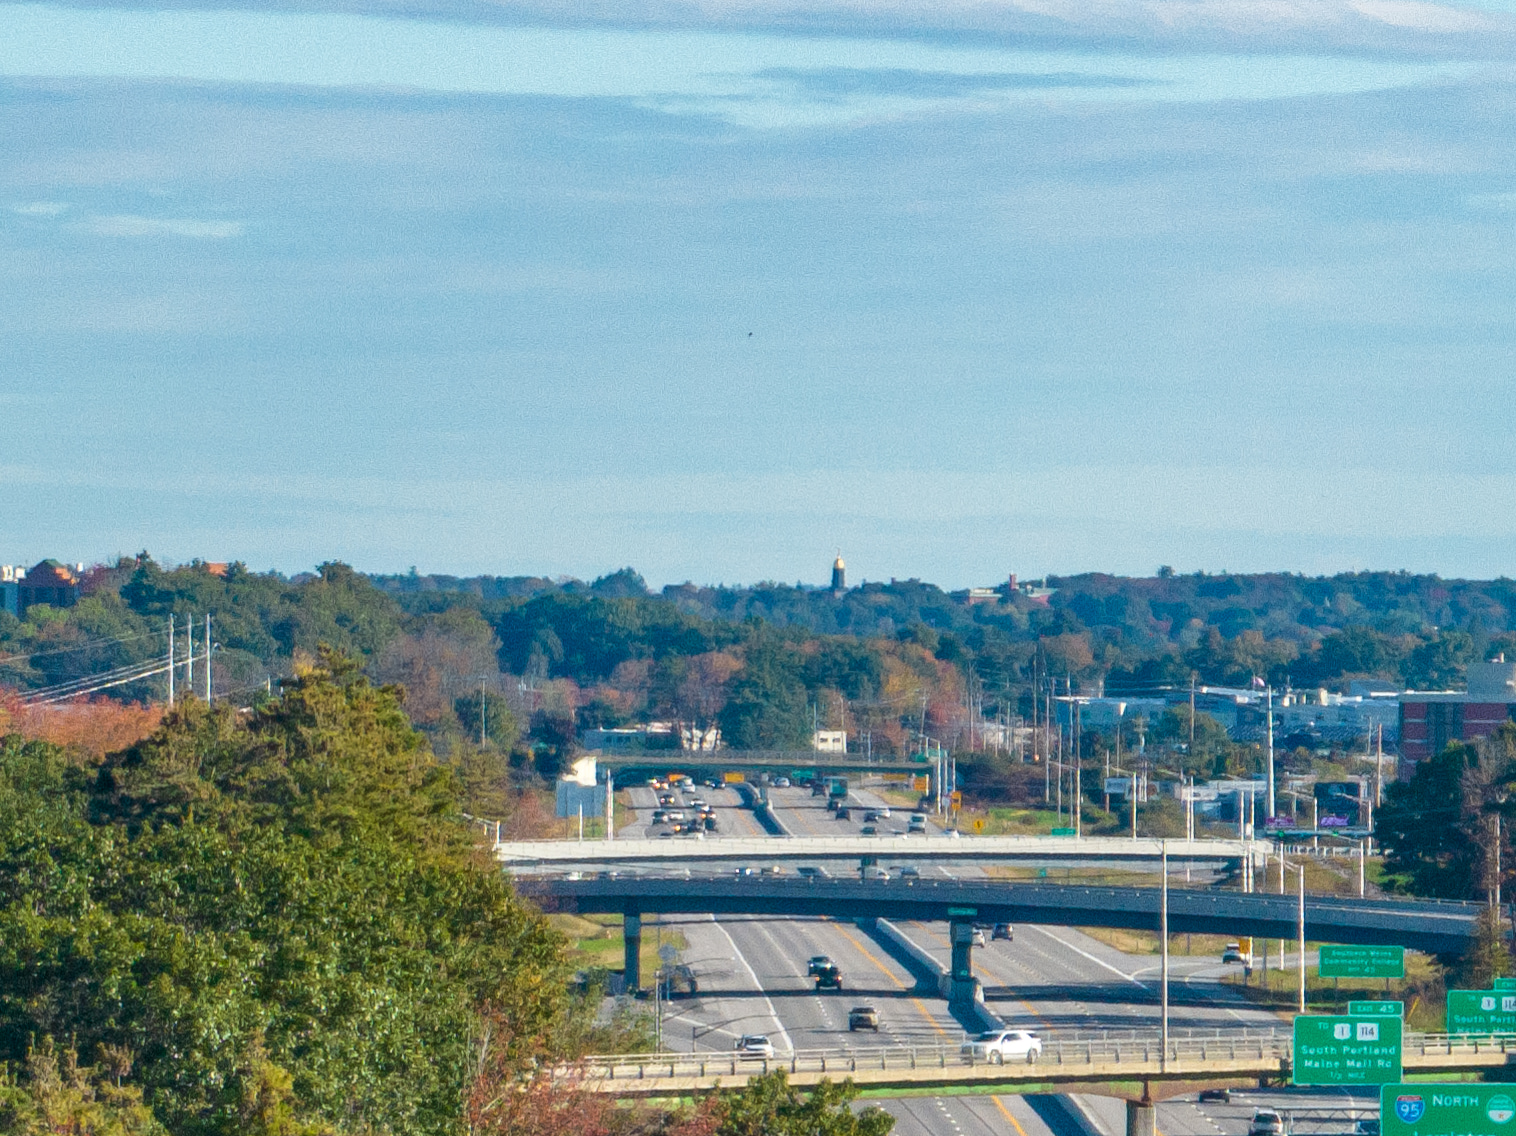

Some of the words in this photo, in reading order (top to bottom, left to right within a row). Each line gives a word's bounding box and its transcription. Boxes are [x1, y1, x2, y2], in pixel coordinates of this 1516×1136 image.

[1380, 1004, 1394, 1012] 45
[1454, 1014, 1485, 1022] South
[1361, 1026, 1374, 1036] 114
[1301, 1045, 1337, 1054] South
[1342, 1045, 1396, 1054] Portland
[1304, 1059, 1340, 1068] Maine
[1346, 1059, 1372, 1068] Mall
[1378, 1059, 1392, 1068] Rd
[1432, 1094, 1479, 1107] NORTH
[1400, 1104, 1420, 1118] 95
